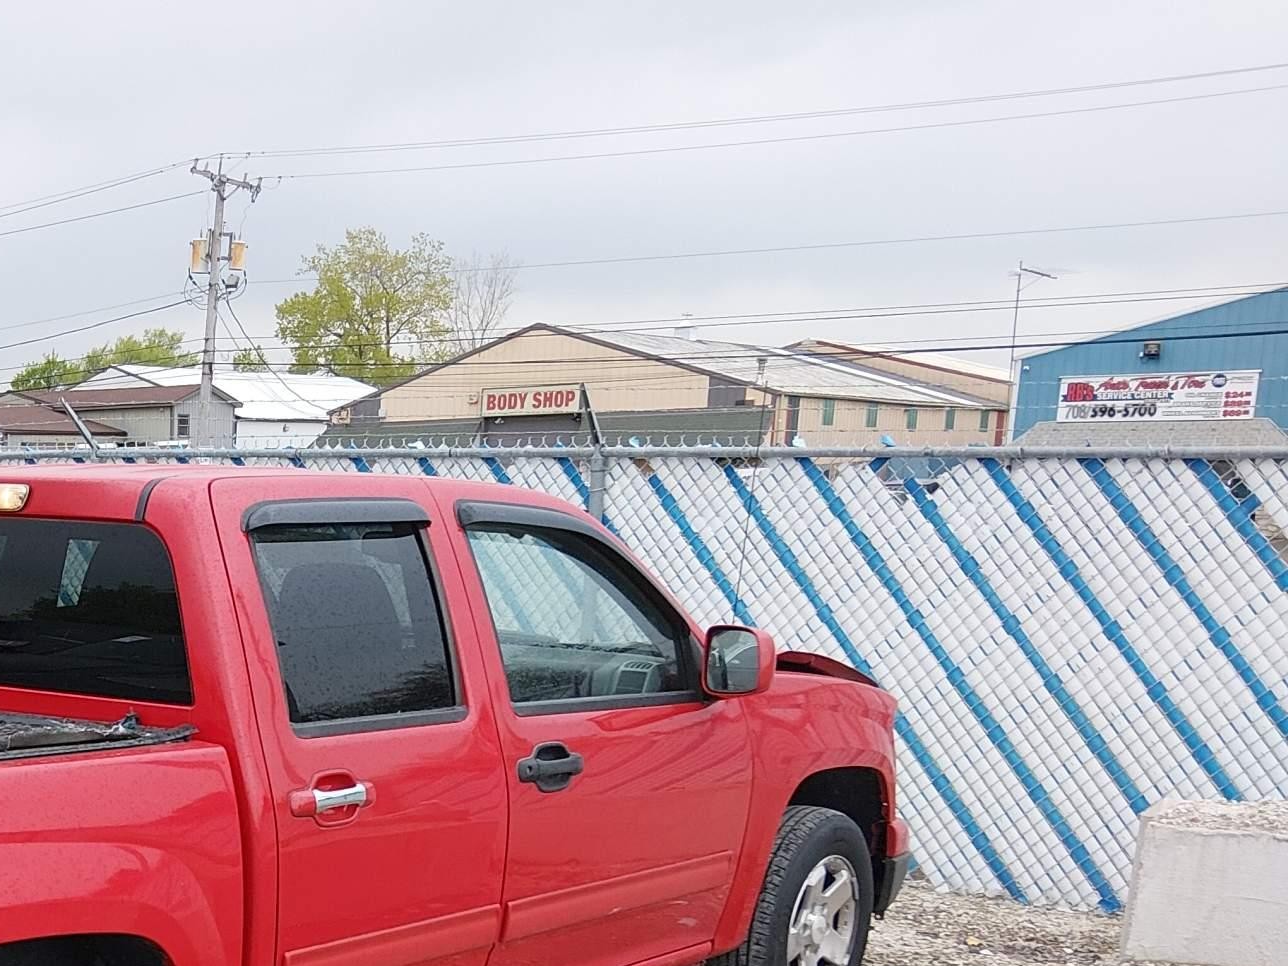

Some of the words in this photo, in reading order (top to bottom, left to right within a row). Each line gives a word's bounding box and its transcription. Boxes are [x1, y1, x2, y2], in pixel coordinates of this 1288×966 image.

[487, 392, 528, 410] BODY
[532, 390, 575, 408] SHOP
[1096, 391, 1132, 400] SERVICE
[1134, 391, 1169, 400] CENTER
[1065, 403, 1157, 418] 708/596-5700
